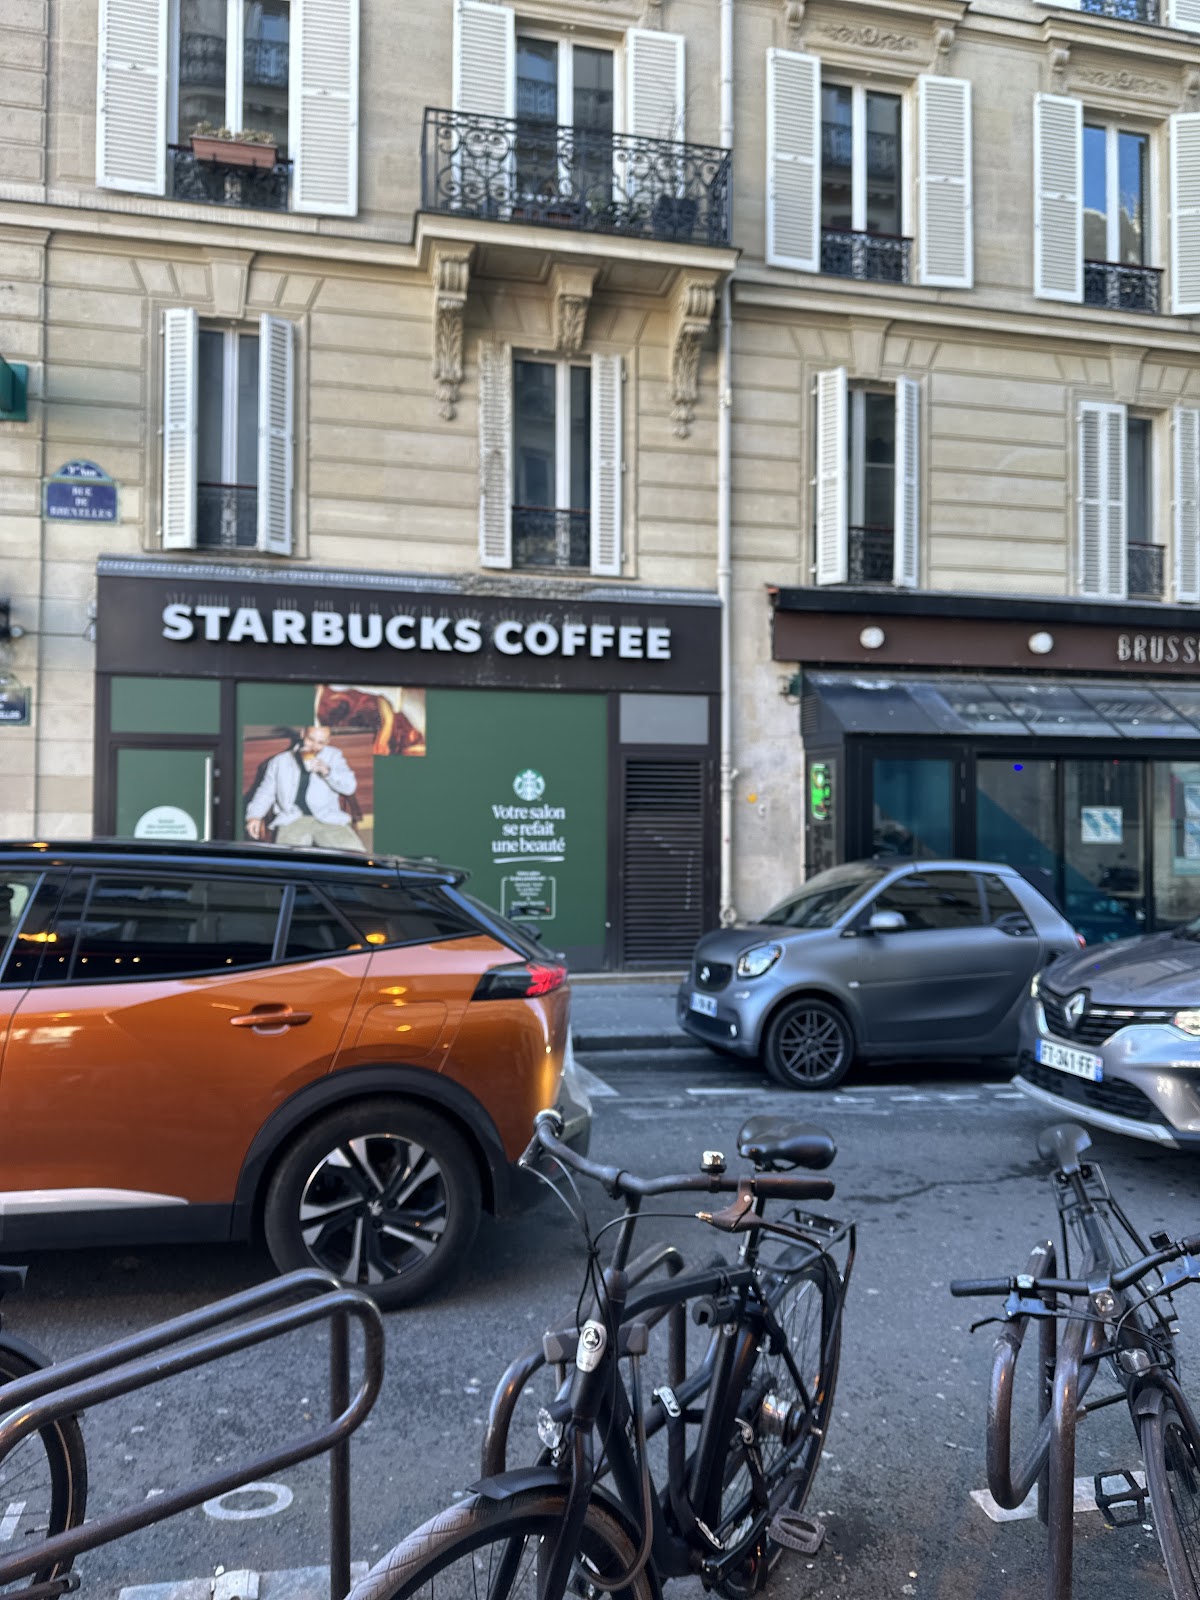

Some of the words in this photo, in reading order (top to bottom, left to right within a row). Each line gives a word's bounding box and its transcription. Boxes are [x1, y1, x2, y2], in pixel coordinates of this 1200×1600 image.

[161, 603, 483, 653] STARBUCKS
[493, 620, 672, 660] COFFEE
[1117, 633, 1200, 664] BRUSS
[492, 804, 528, 819] Votre
[529, 803, 565, 819] salon
[502, 823, 518, 836] se
[519, 820, 555, 836] refait
[492, 840, 518, 852] une
[519, 836, 566, 853] beauté
